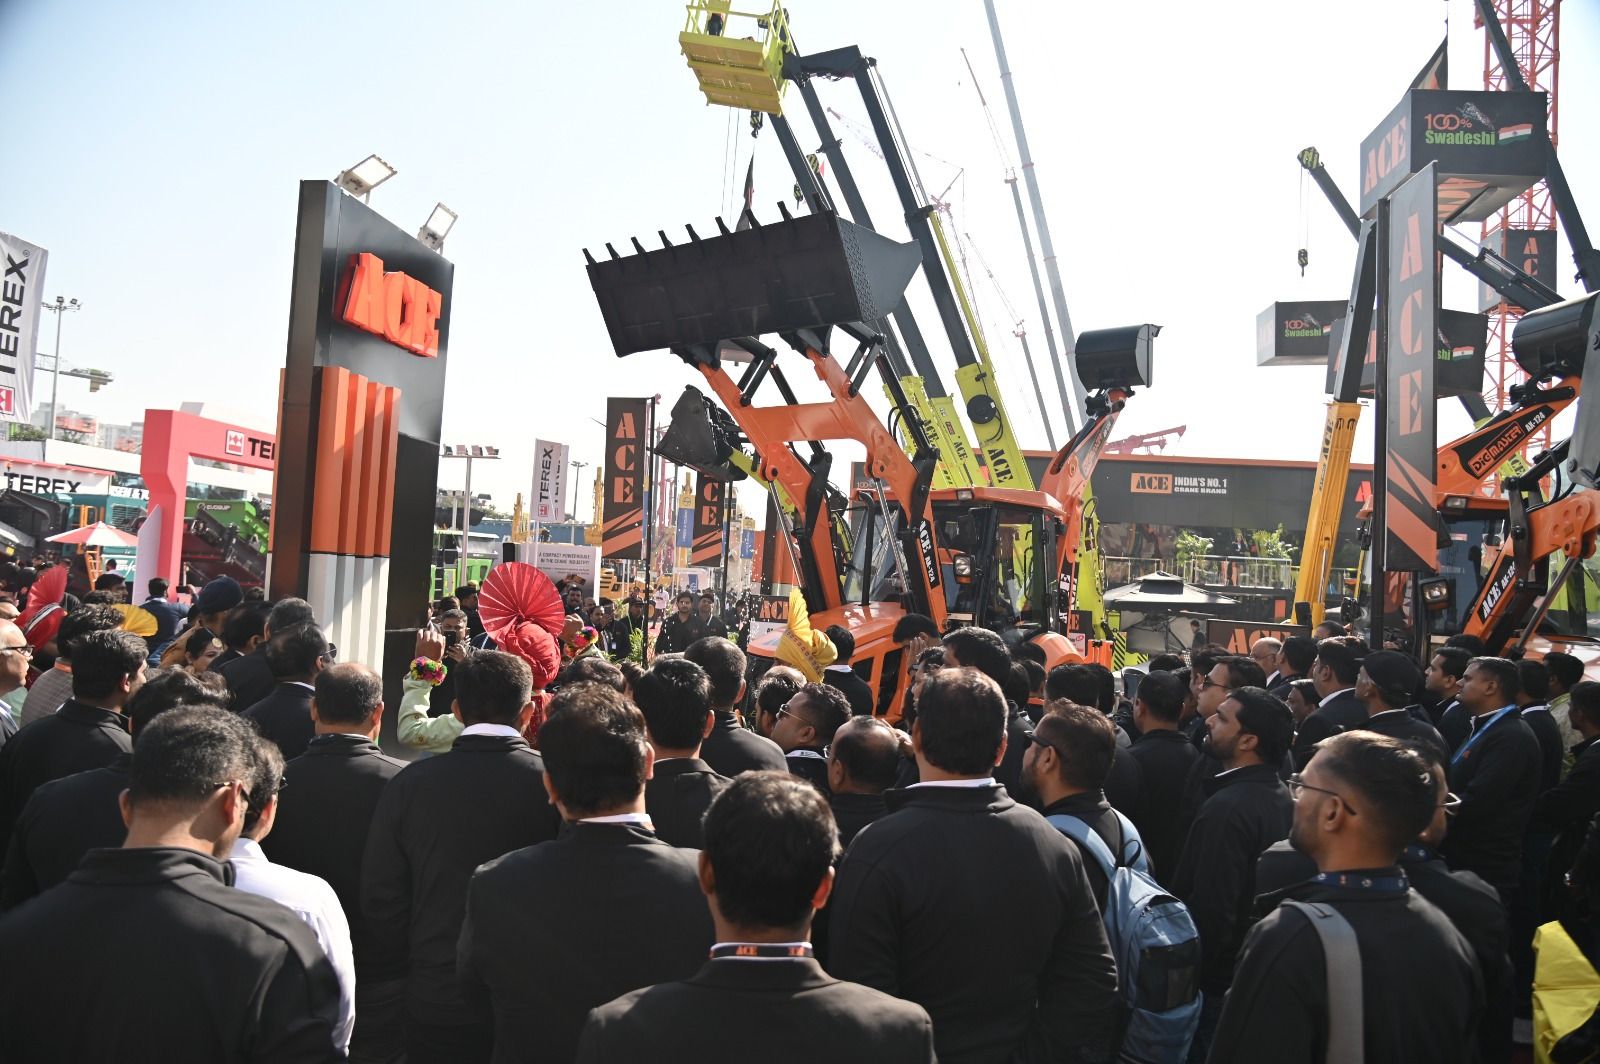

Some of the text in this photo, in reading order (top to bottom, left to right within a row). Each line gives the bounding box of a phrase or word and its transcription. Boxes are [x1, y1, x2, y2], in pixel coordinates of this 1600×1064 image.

[1424, 114, 1472, 131] 100%
[1425, 130, 1496, 146] Swadeshi
[1364, 115, 1407, 195] ACE
[343, 252, 443, 358] ACE
[1284, 328, 1322, 337] Swadeshi
[614, 412, 636, 504] ACE
[988, 448, 1014, 484] ACE
[539, 447, 554, 503] TEREX
[1136, 475, 1169, 490] ACE
[1174, 476, 1228, 488] INDIA'S NO. 1
[1482, 582, 1502, 619] ACE
[736, 946, 758, 956] ACE
